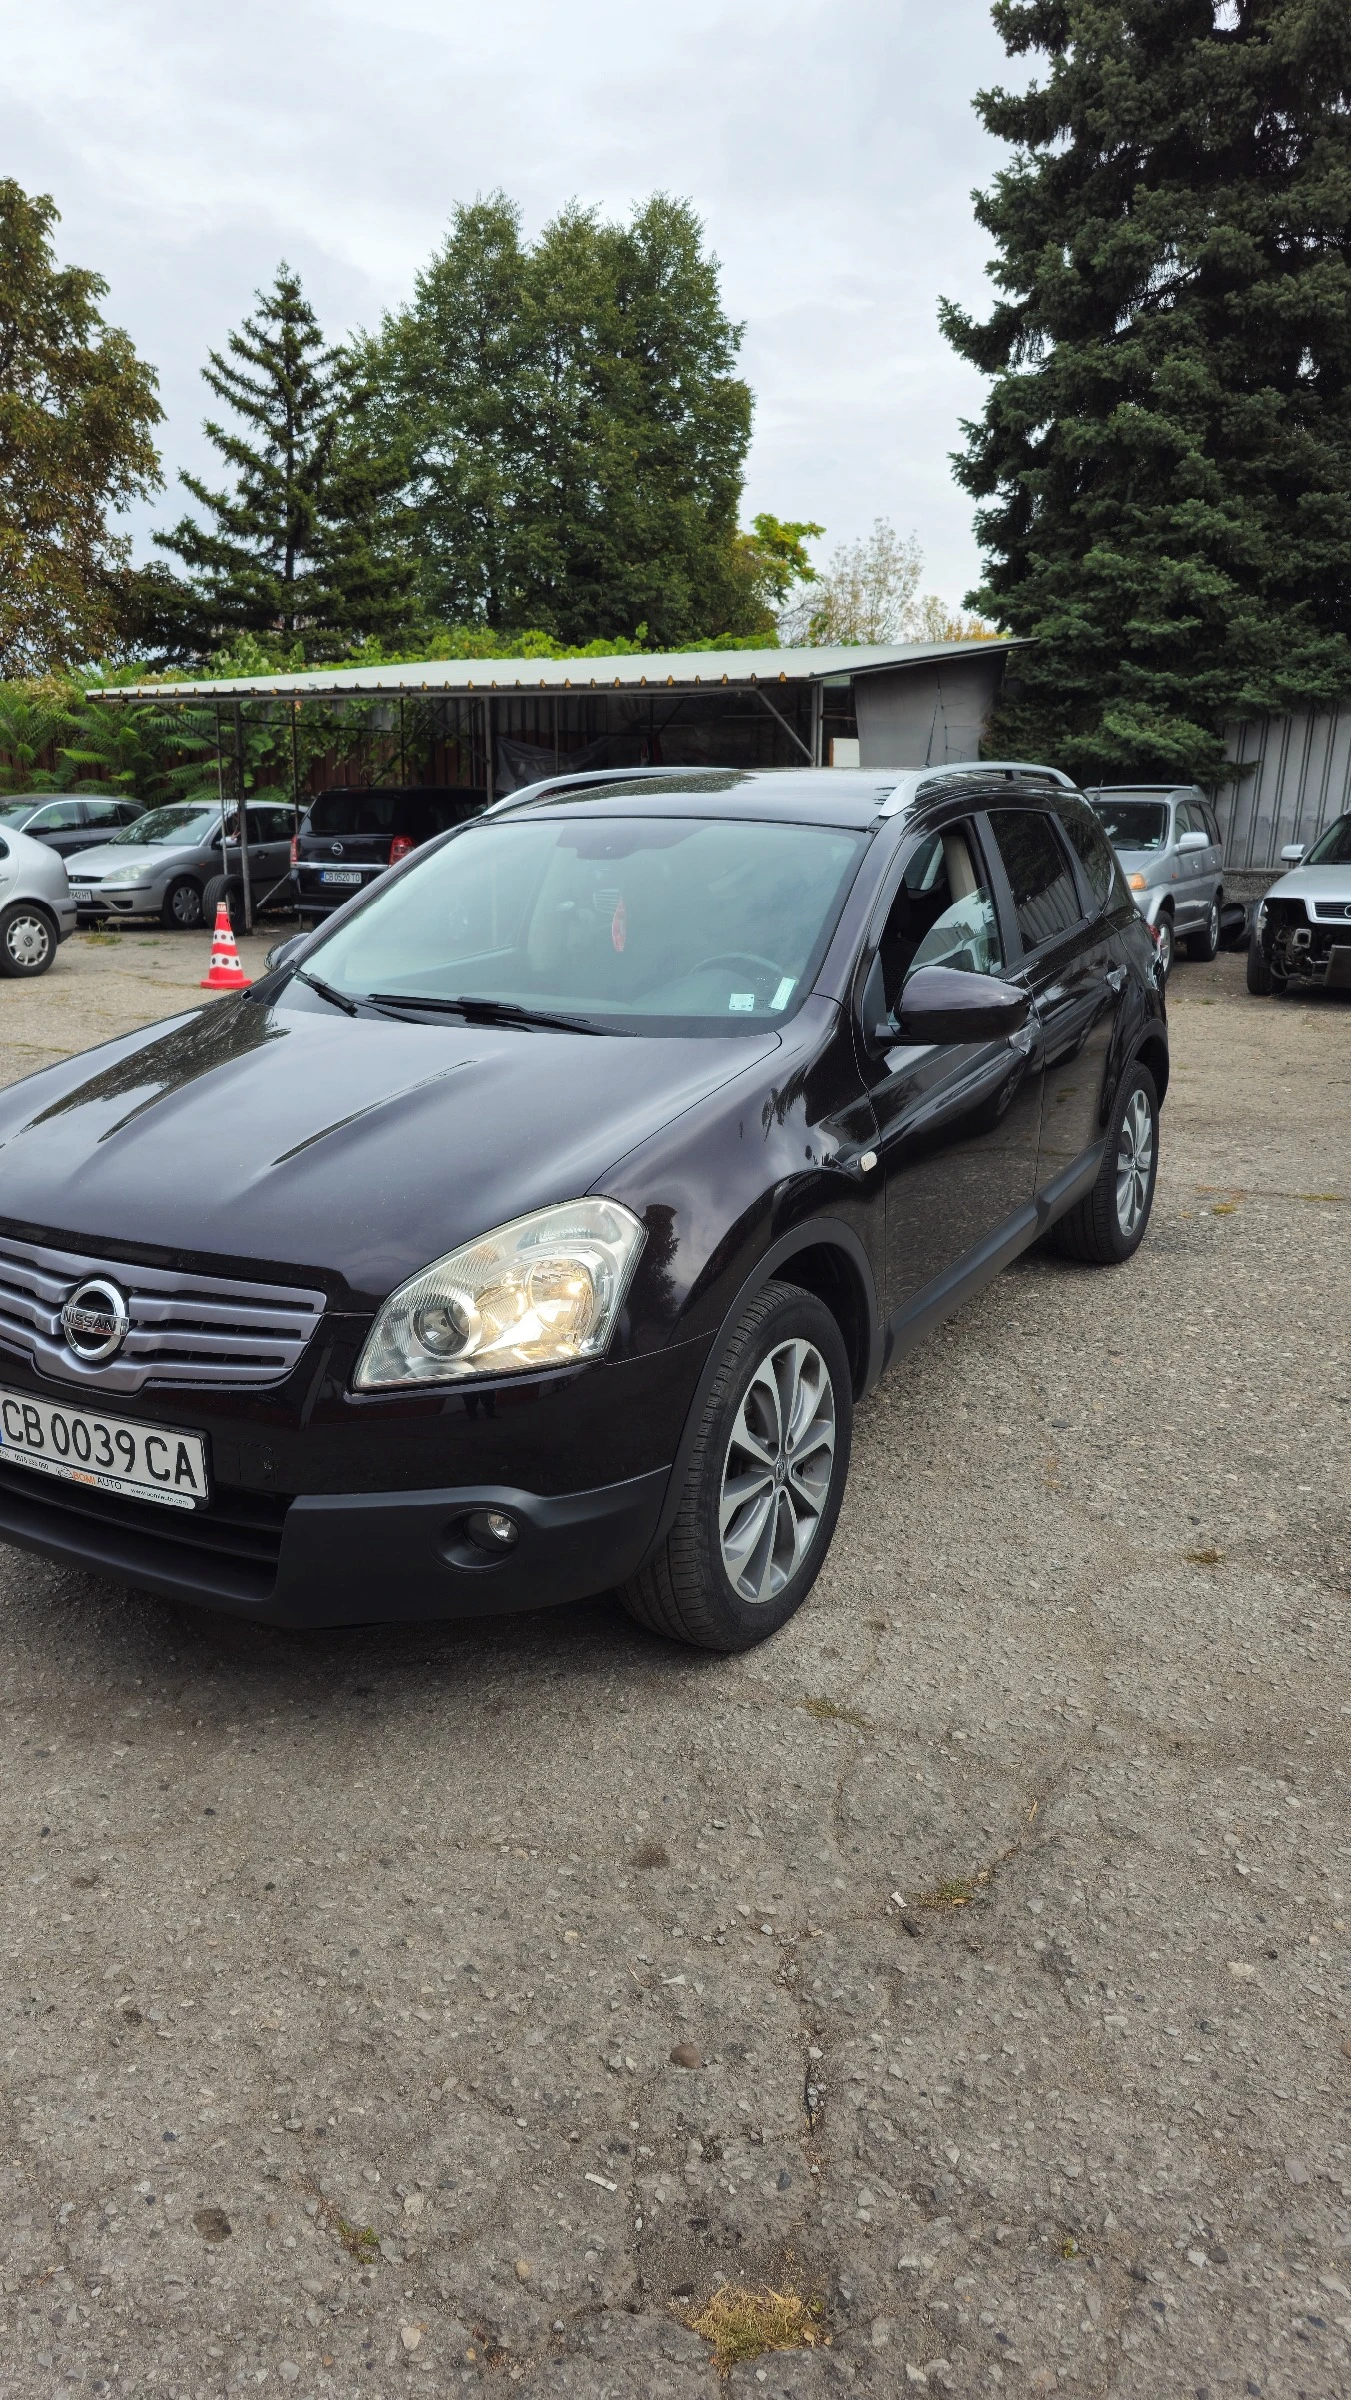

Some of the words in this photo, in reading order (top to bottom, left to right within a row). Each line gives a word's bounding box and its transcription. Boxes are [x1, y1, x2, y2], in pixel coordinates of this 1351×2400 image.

[63, 1308, 118, 1332] NISSAN
[1, 1399, 45, 1449] CB
[51, 1412, 136, 1473] 0039
[144, 1435, 198, 1489] CA
[72, 1470, 96, 1485] BOMI
[97, 1478, 122, 1490] AUTO
